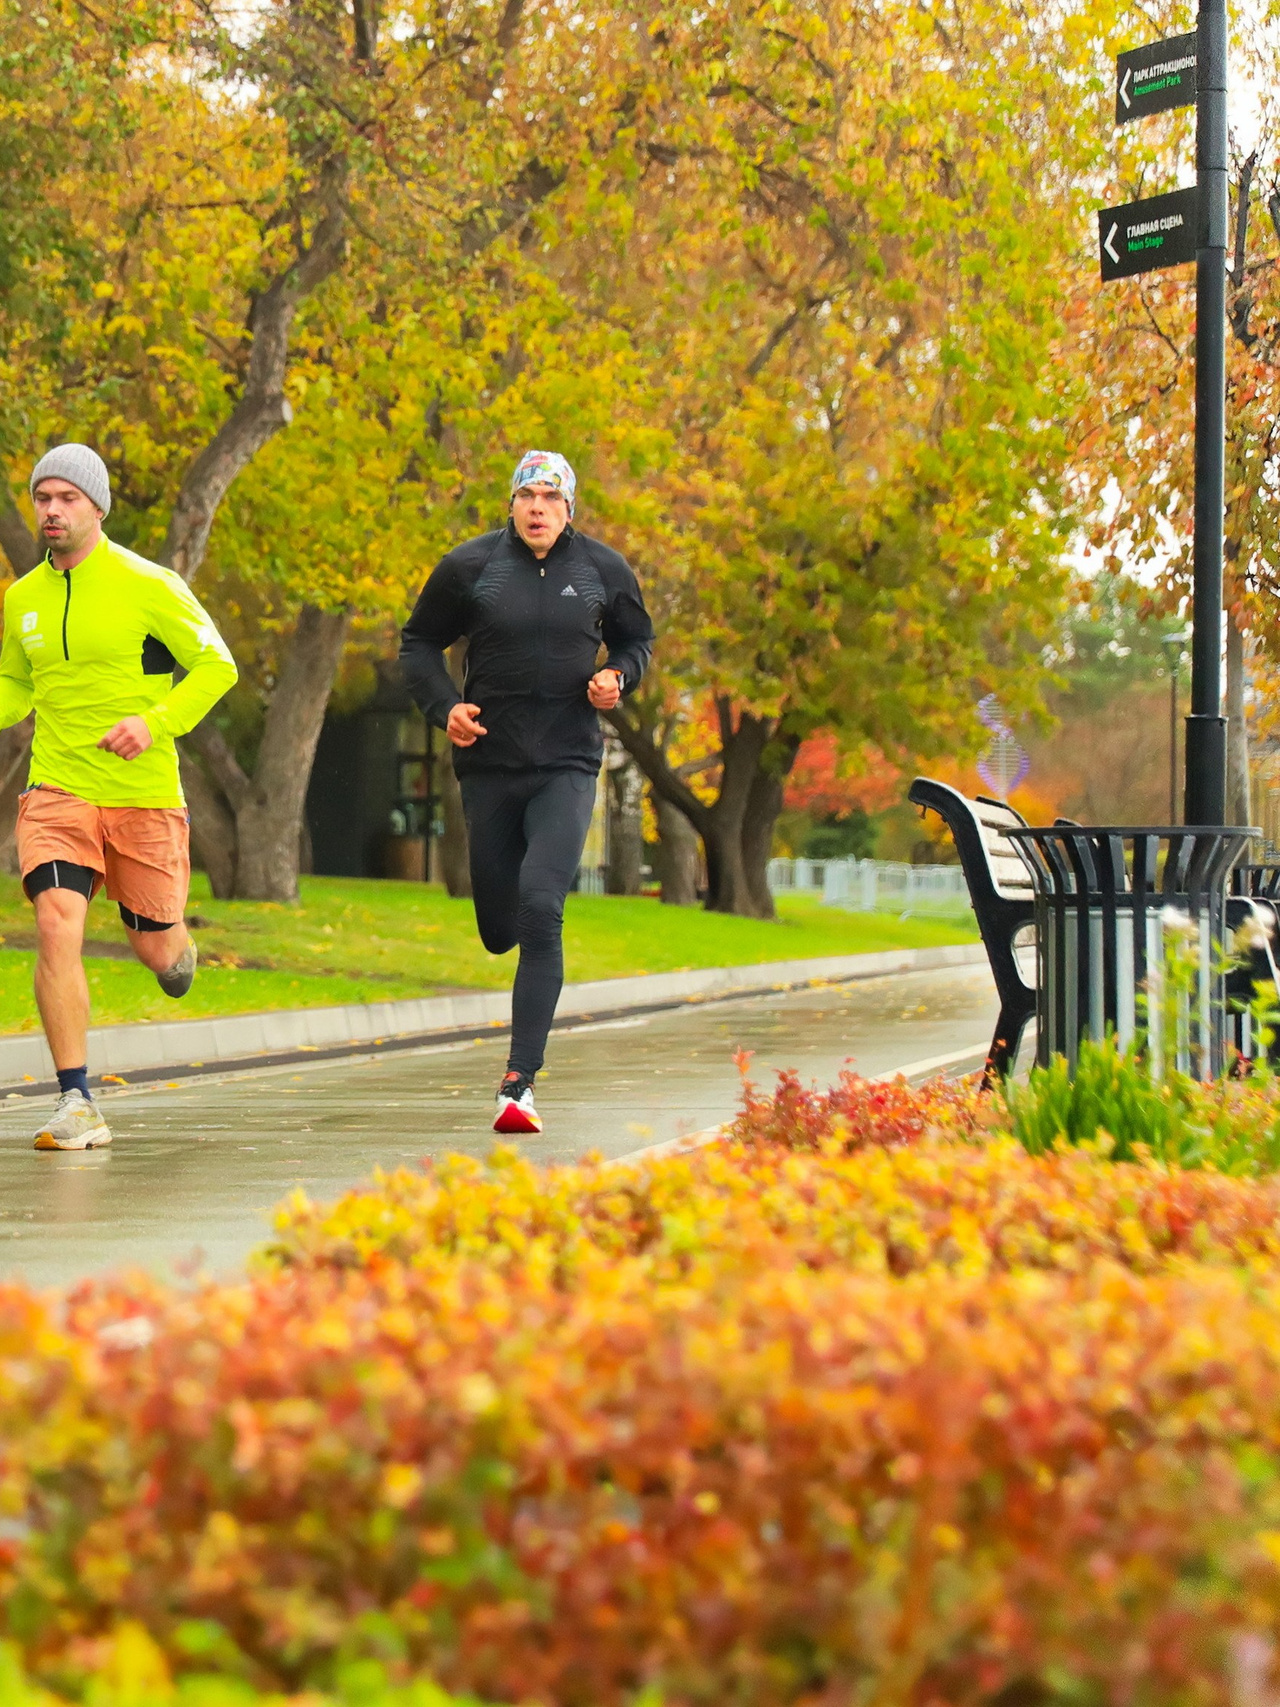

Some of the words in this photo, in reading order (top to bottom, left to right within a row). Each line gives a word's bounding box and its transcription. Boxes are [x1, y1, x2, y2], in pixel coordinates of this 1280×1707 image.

[1133, 68, 1149, 84] ПАРК
[1149, 55, 1197, 79] АТТРАКЦИОНО
[1166, 73, 1181, 88] Park
[1126, 219, 1160, 239] ГЛАВНАЯ
[1160, 213, 1184, 231] СЦЕНА
[1128, 239, 1144, 252] Main
[1145, 236, 1164, 249] Stage
